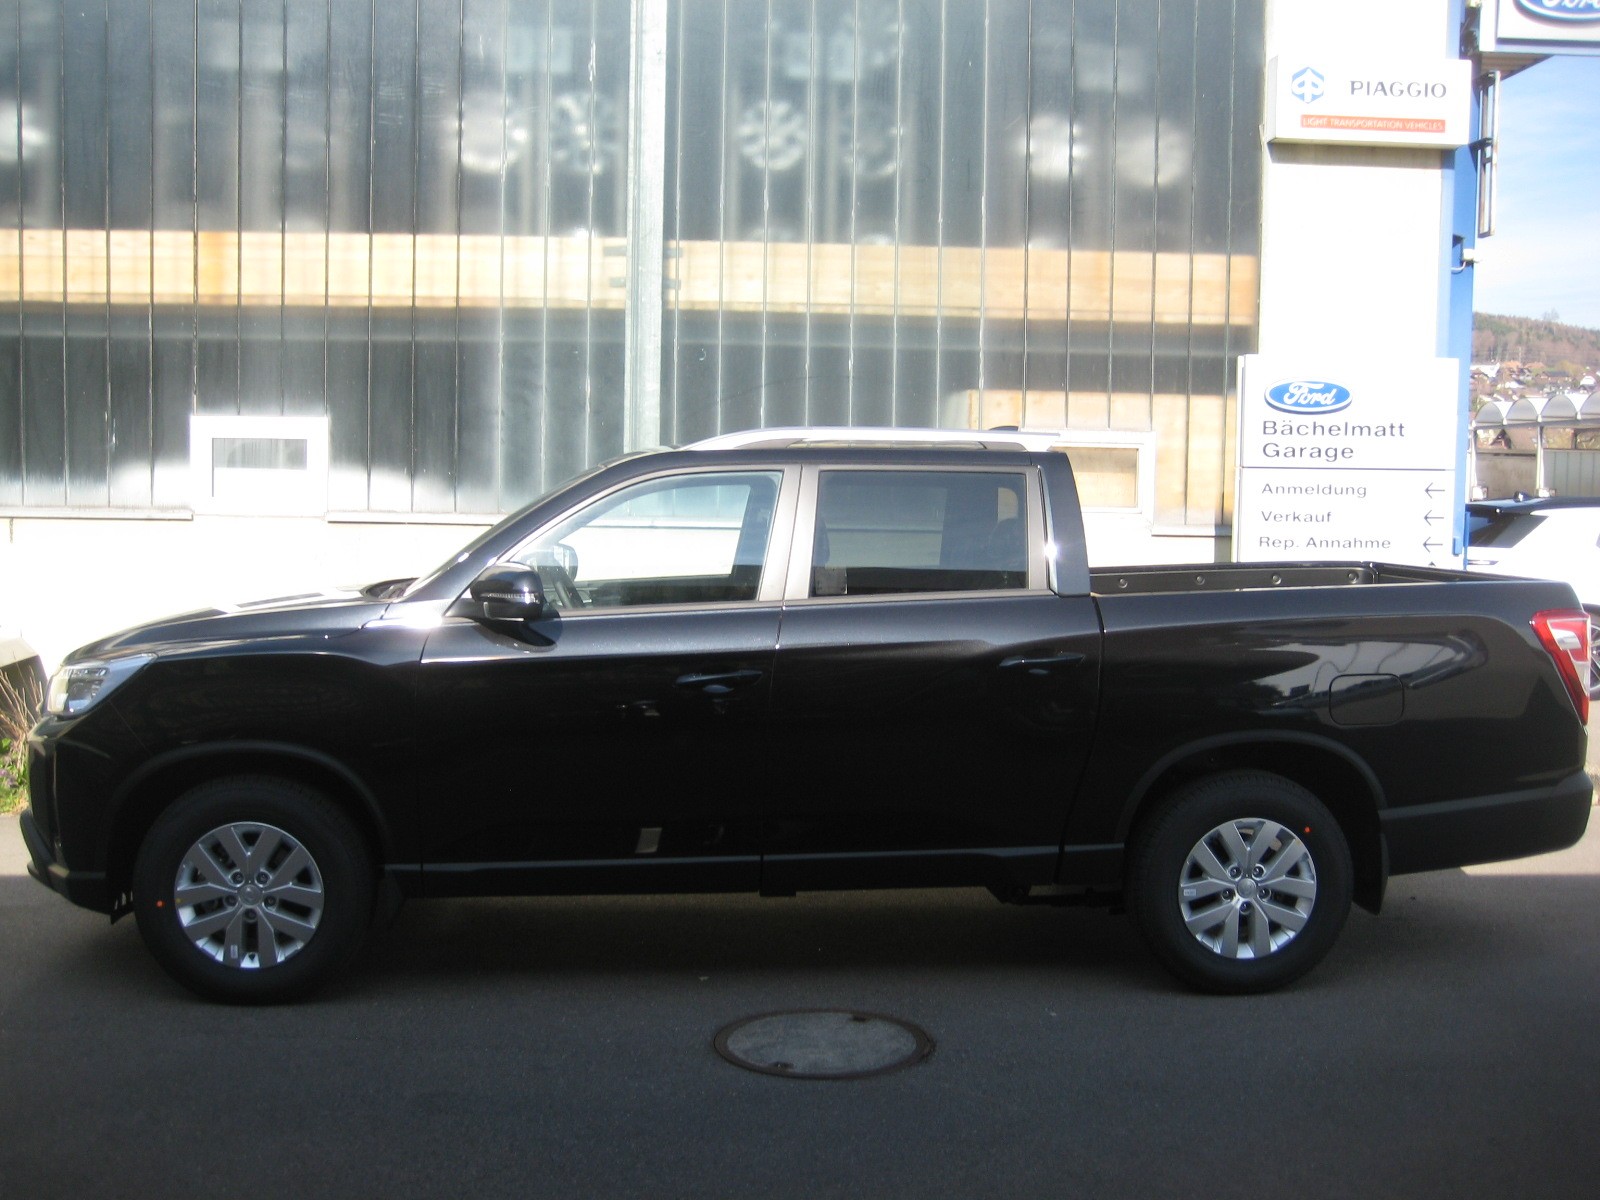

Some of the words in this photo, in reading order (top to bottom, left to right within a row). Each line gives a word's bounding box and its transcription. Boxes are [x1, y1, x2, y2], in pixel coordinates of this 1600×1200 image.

[1350, 80, 1447, 98] PIAGGIO
[1303, 117, 1328, 127] LIGHT
[1330, 118, 1402, 130] TRANSPORTATION
[1405, 121, 1443, 131] VEHICLES
[1283, 381, 1337, 406] Ford
[1262, 419, 1405, 438] Bächelmatt
[1262, 442, 1354, 463] Garage
[1261, 483, 1367, 499] Anmeldung
[1261, 510, 1332, 523] Verkauf
[1259, 536, 1300, 549] Rep.
[1306, 537, 1391, 549] Annahme
